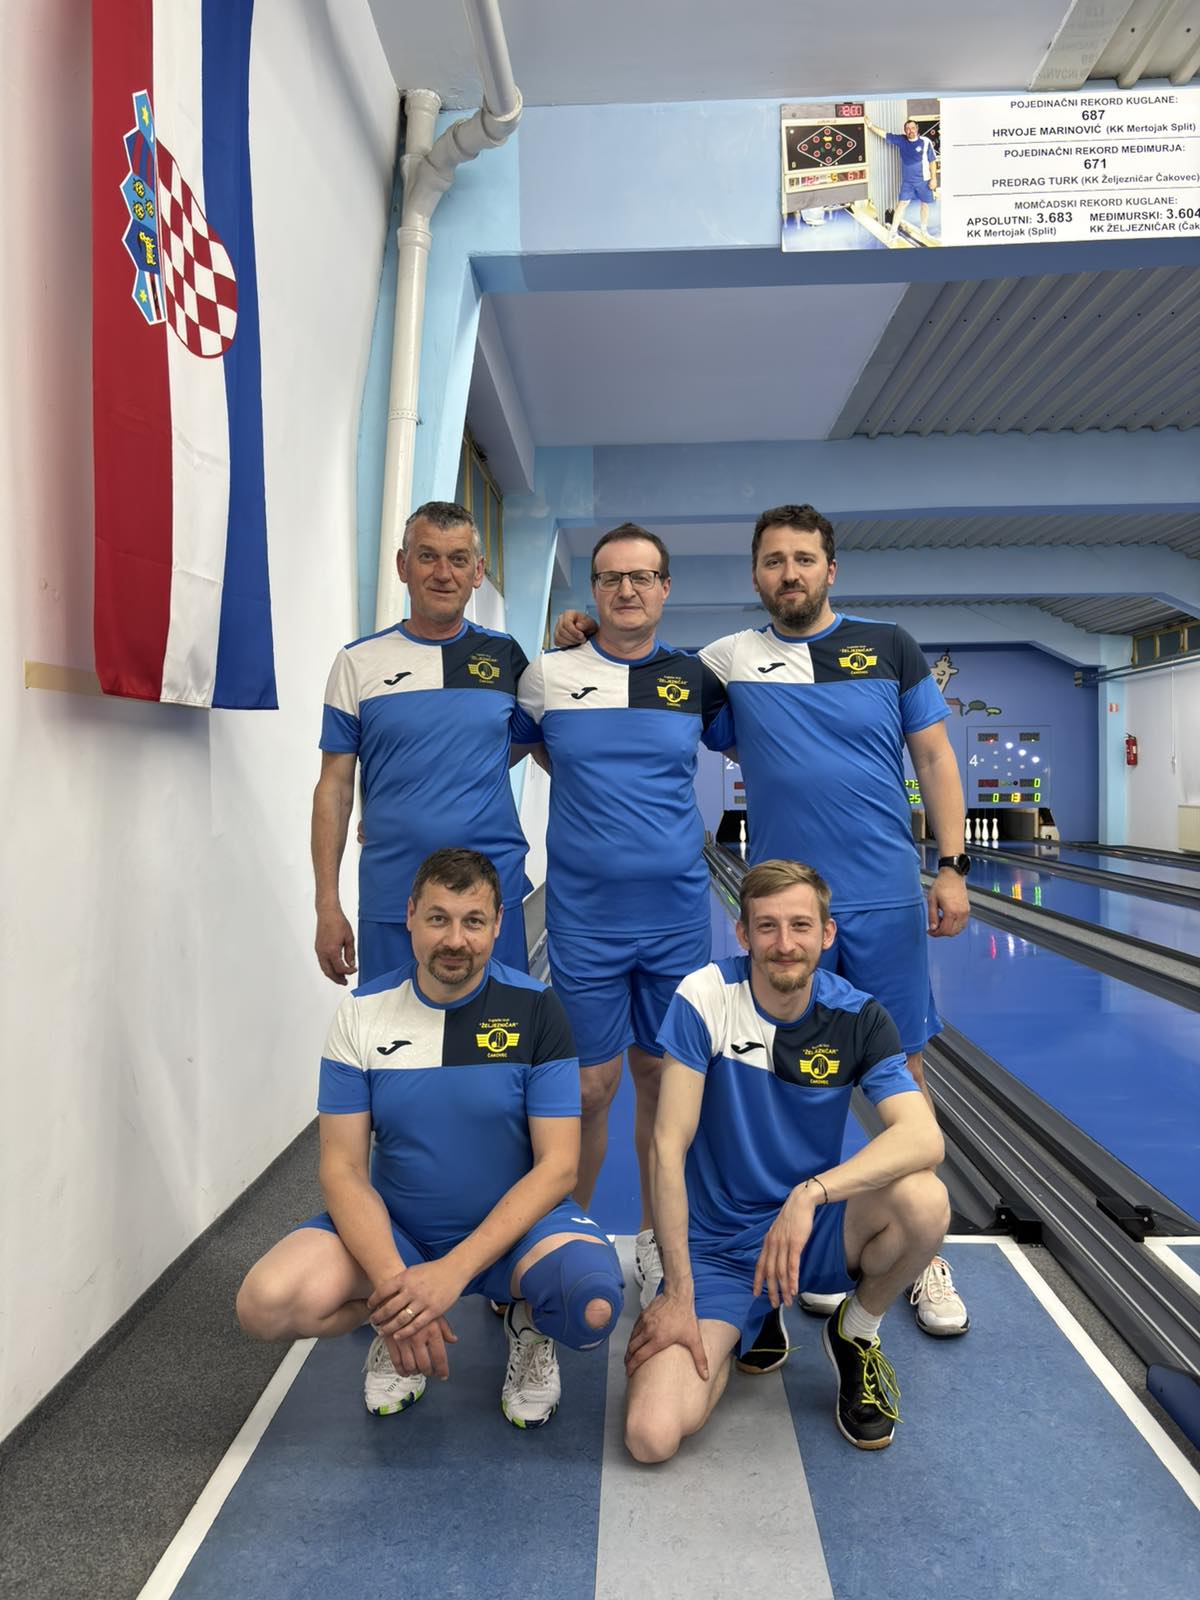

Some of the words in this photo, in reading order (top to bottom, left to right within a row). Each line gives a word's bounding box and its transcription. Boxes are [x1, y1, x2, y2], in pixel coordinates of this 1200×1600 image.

[1010, 98, 1078, 109] POJEDINAČNI
[1080, 97, 1123, 106] REKORD
[1126, 95, 1178, 105] KUGLANE:
[1081, 109, 1105, 121] 687
[992, 127, 1037, 137] HRVOJE
[1039, 123, 1102, 135] MARINOVIĆ
[1106, 125, 1124, 135] (KK
[1126, 123, 1168, 133] Mertojak
[1171, 122, 1196, 132] Split)
[1004, 146, 1073, 157] POJEDINAČNI
[1075, 146, 1119, 155] REKORD
[1083, 158, 1107, 170] 671
[992, 177, 1046, 188] PREDRAG
[1048, 176, 1079, 186] TURK
[1081, 175, 1099, 186] (KK
[1101, 174, 1153, 185] Željezničar
[1155, 172, 1200, 182] Čakovec)
[1014, 199, 1077, 210] MOMČADSKI
[1080, 198, 1123, 207] REKORD
[1125, 196, 1178, 206] KUGLANE:
[966, 215, 1033, 226] APSOLUTNI:
[1036, 211, 1073, 224] 3.683
[1089, 211, 1163, 222] MEĐIMURSKI:
[1166, 207, 1200, 219] 3.604
[966, 229, 981, 238] KK
[984, 228, 1025, 238] Mertojak
[1028, 226, 1057, 237] (Split)
[1089, 224, 1104, 233] KK
[1107, 221, 1176, 233] ŽELJEZNIČAR
[969, 754, 979, 767] 4
[1033, 778, 1041, 788] 0
[992, 792, 1000, 803] 0
[1033, 792, 1041, 803] 0
